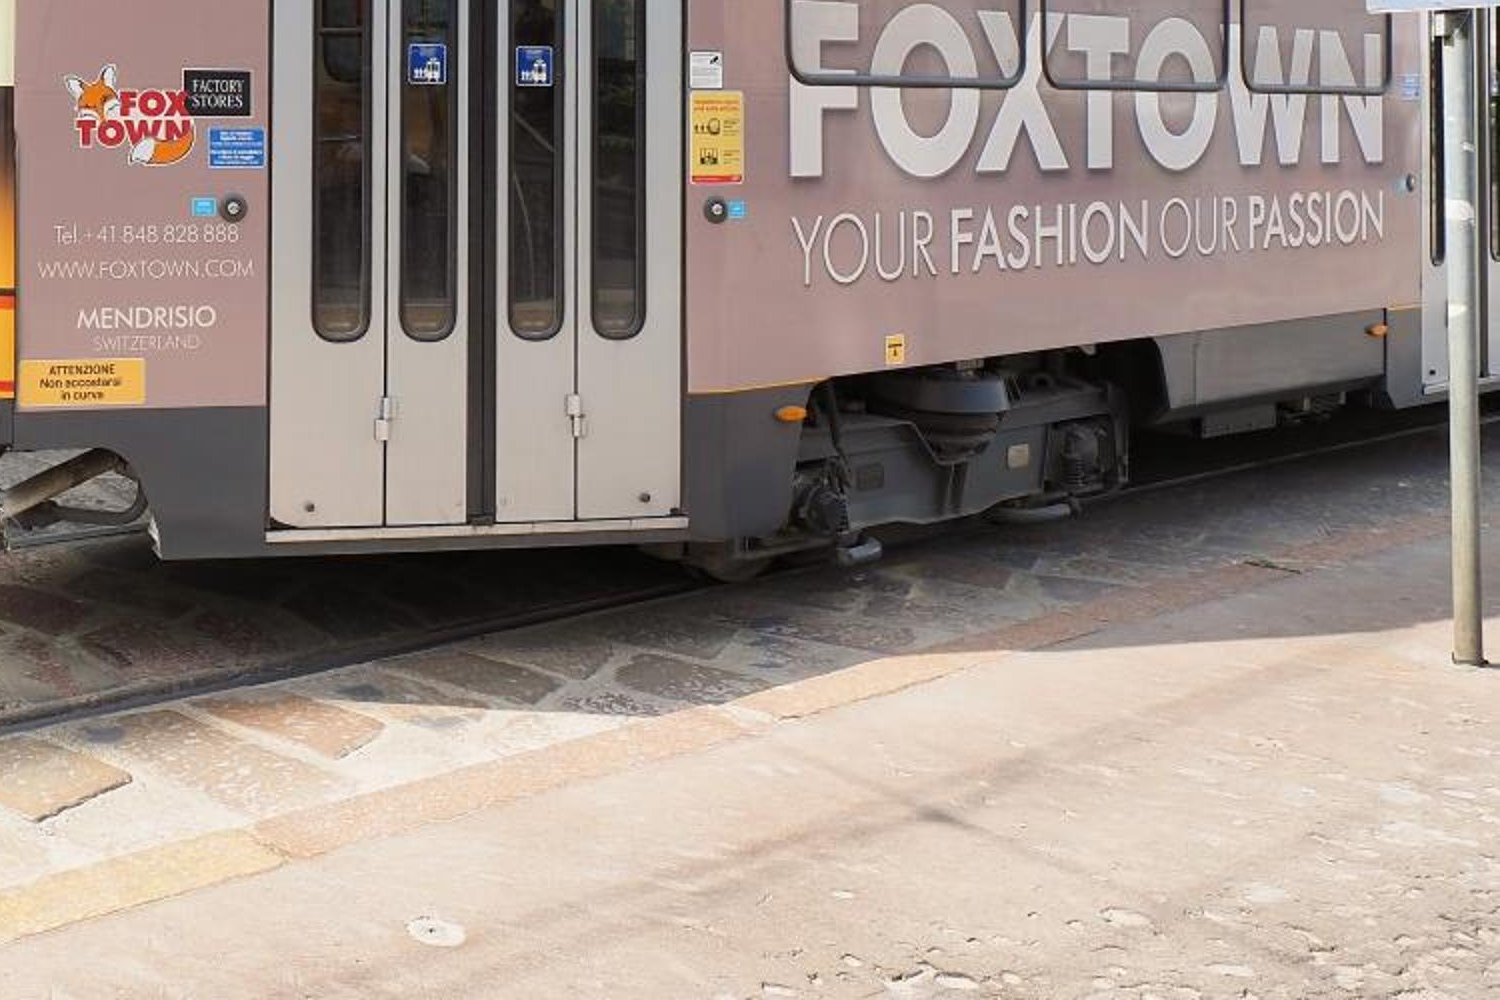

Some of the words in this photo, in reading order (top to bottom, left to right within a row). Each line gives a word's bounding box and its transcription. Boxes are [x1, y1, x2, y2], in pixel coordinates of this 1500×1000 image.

[192, 79, 244, 93] FACTORY
[790, 0, 1383, 178] FOXTOWN
[119, 90, 189, 117] FOX
[191, 94, 244, 109] STORES
[76, 119, 191, 147] TOWN
[123, 224, 159, 243] 848
[163, 223, 199, 243] 828
[203, 223, 240, 242] 888
[790, 211, 938, 287] YOUR
[951, 200, 1149, 274] FASHION
[1159, 196, 1240, 259] OUR
[1248, 189, 1384, 249] PASSION
[37, 259, 254, 279] WWW.FOXTOWN.COM
[77, 304, 217, 329] MENDRISIO
[92, 335, 200, 351] SWITZERLAND
[48, 363, 117, 376] ATTENZIONE
[39, 378, 62, 389] Non
[61, 391, 71, 401] in
